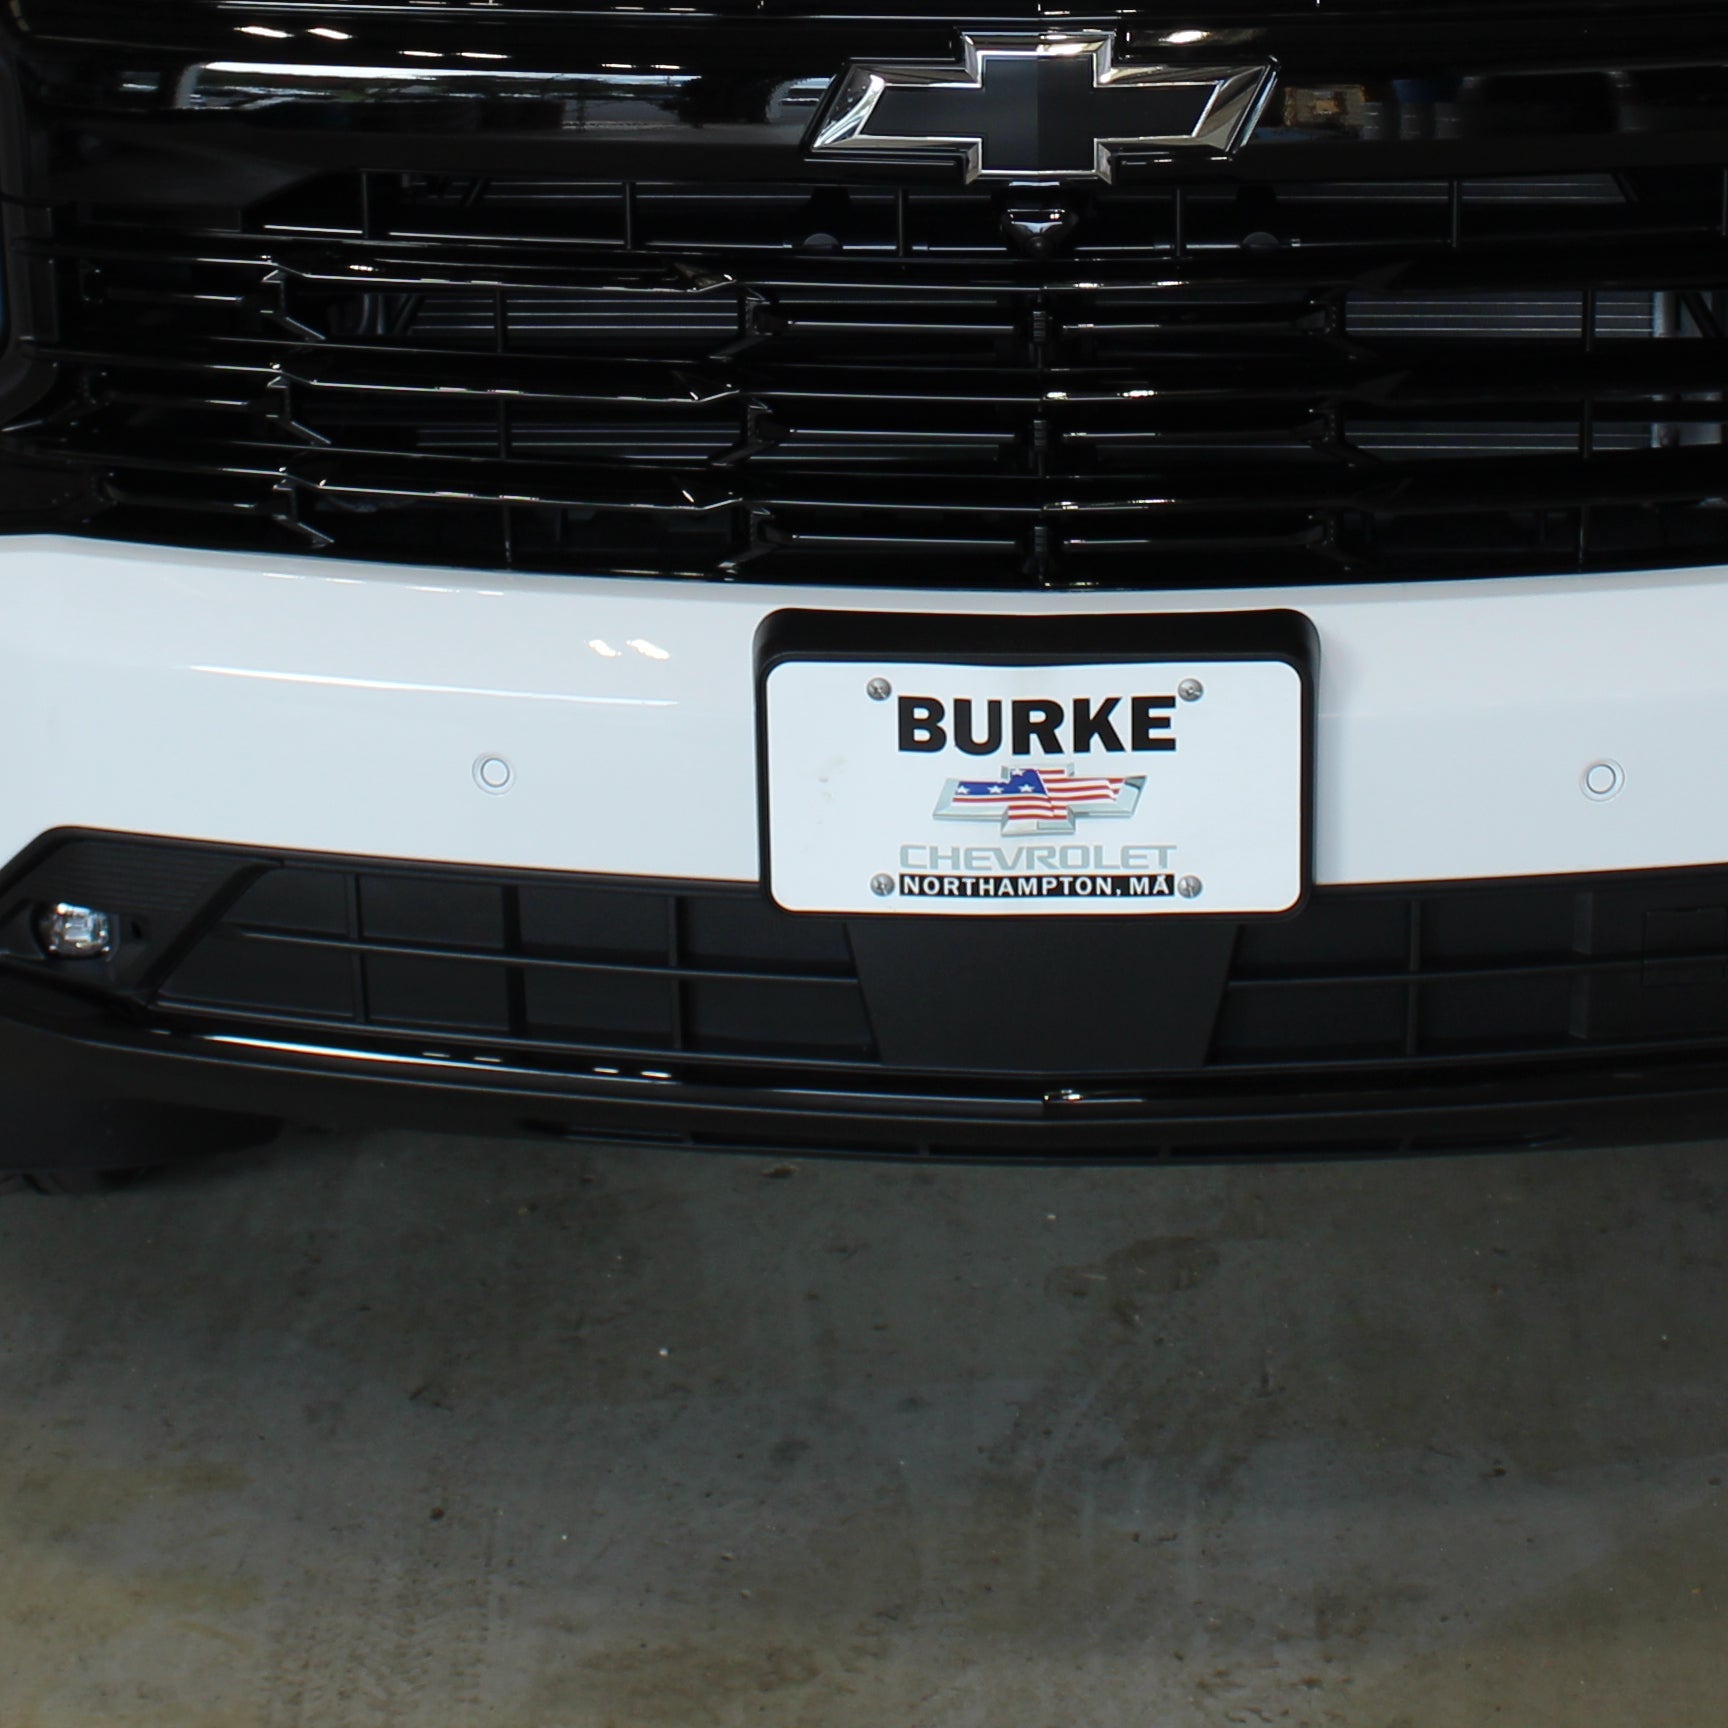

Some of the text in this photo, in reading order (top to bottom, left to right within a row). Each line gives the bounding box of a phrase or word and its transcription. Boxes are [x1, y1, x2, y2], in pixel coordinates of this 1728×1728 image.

[897, 695, 1177, 755] BURKE
[899, 844, 1176, 871] CHEVROLET
[903, 874, 1171, 897] NORTHAMPTON, MA
